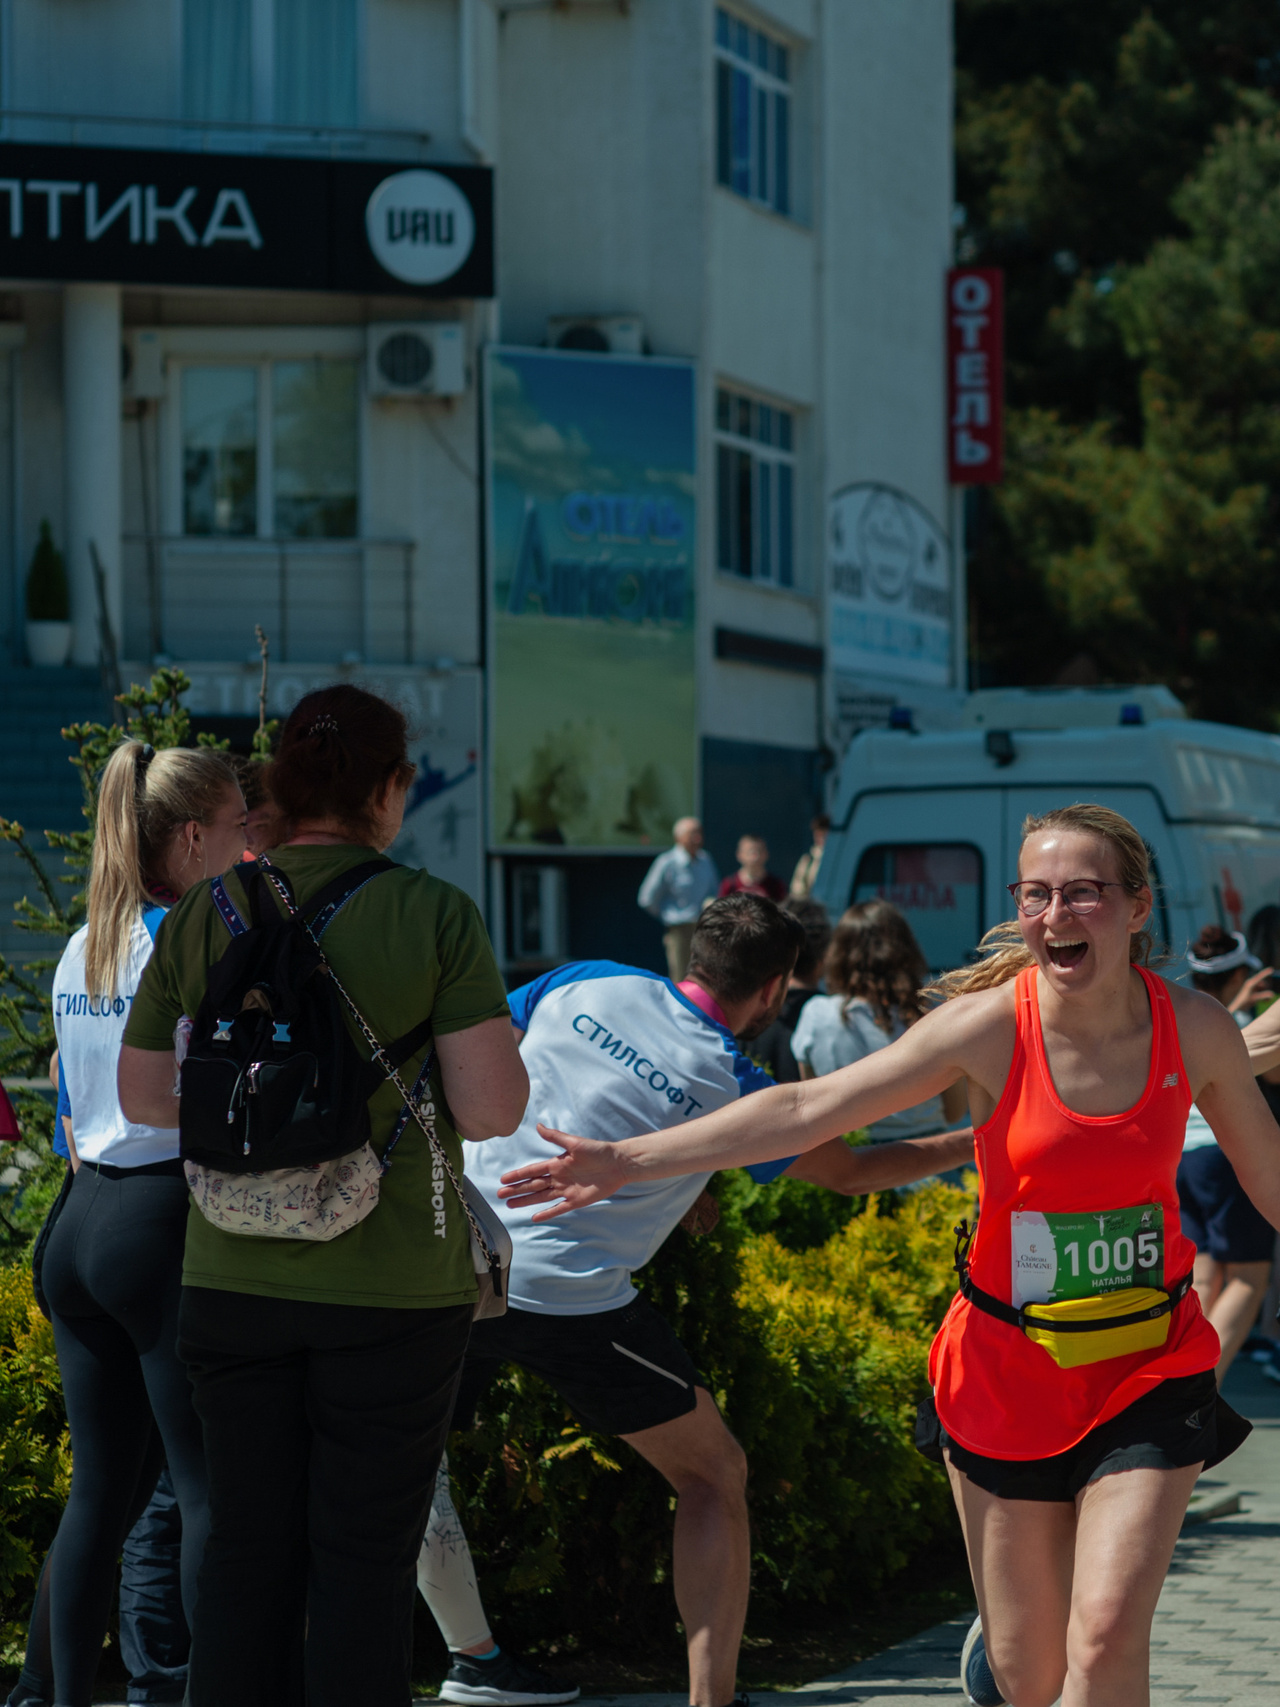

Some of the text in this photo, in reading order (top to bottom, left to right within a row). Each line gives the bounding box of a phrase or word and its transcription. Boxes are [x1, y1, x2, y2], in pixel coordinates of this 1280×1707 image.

[953, 275, 991, 467] ОТЕЛЬ
[571, 1014, 703, 1117] СТИЛСОФТ
[1016, 1260, 1052, 1270] TAMAGNE
[1064, 1232, 1159, 1277] 1005
[1092, 1275, 1132, 1288] НАТАЛЬЯ
